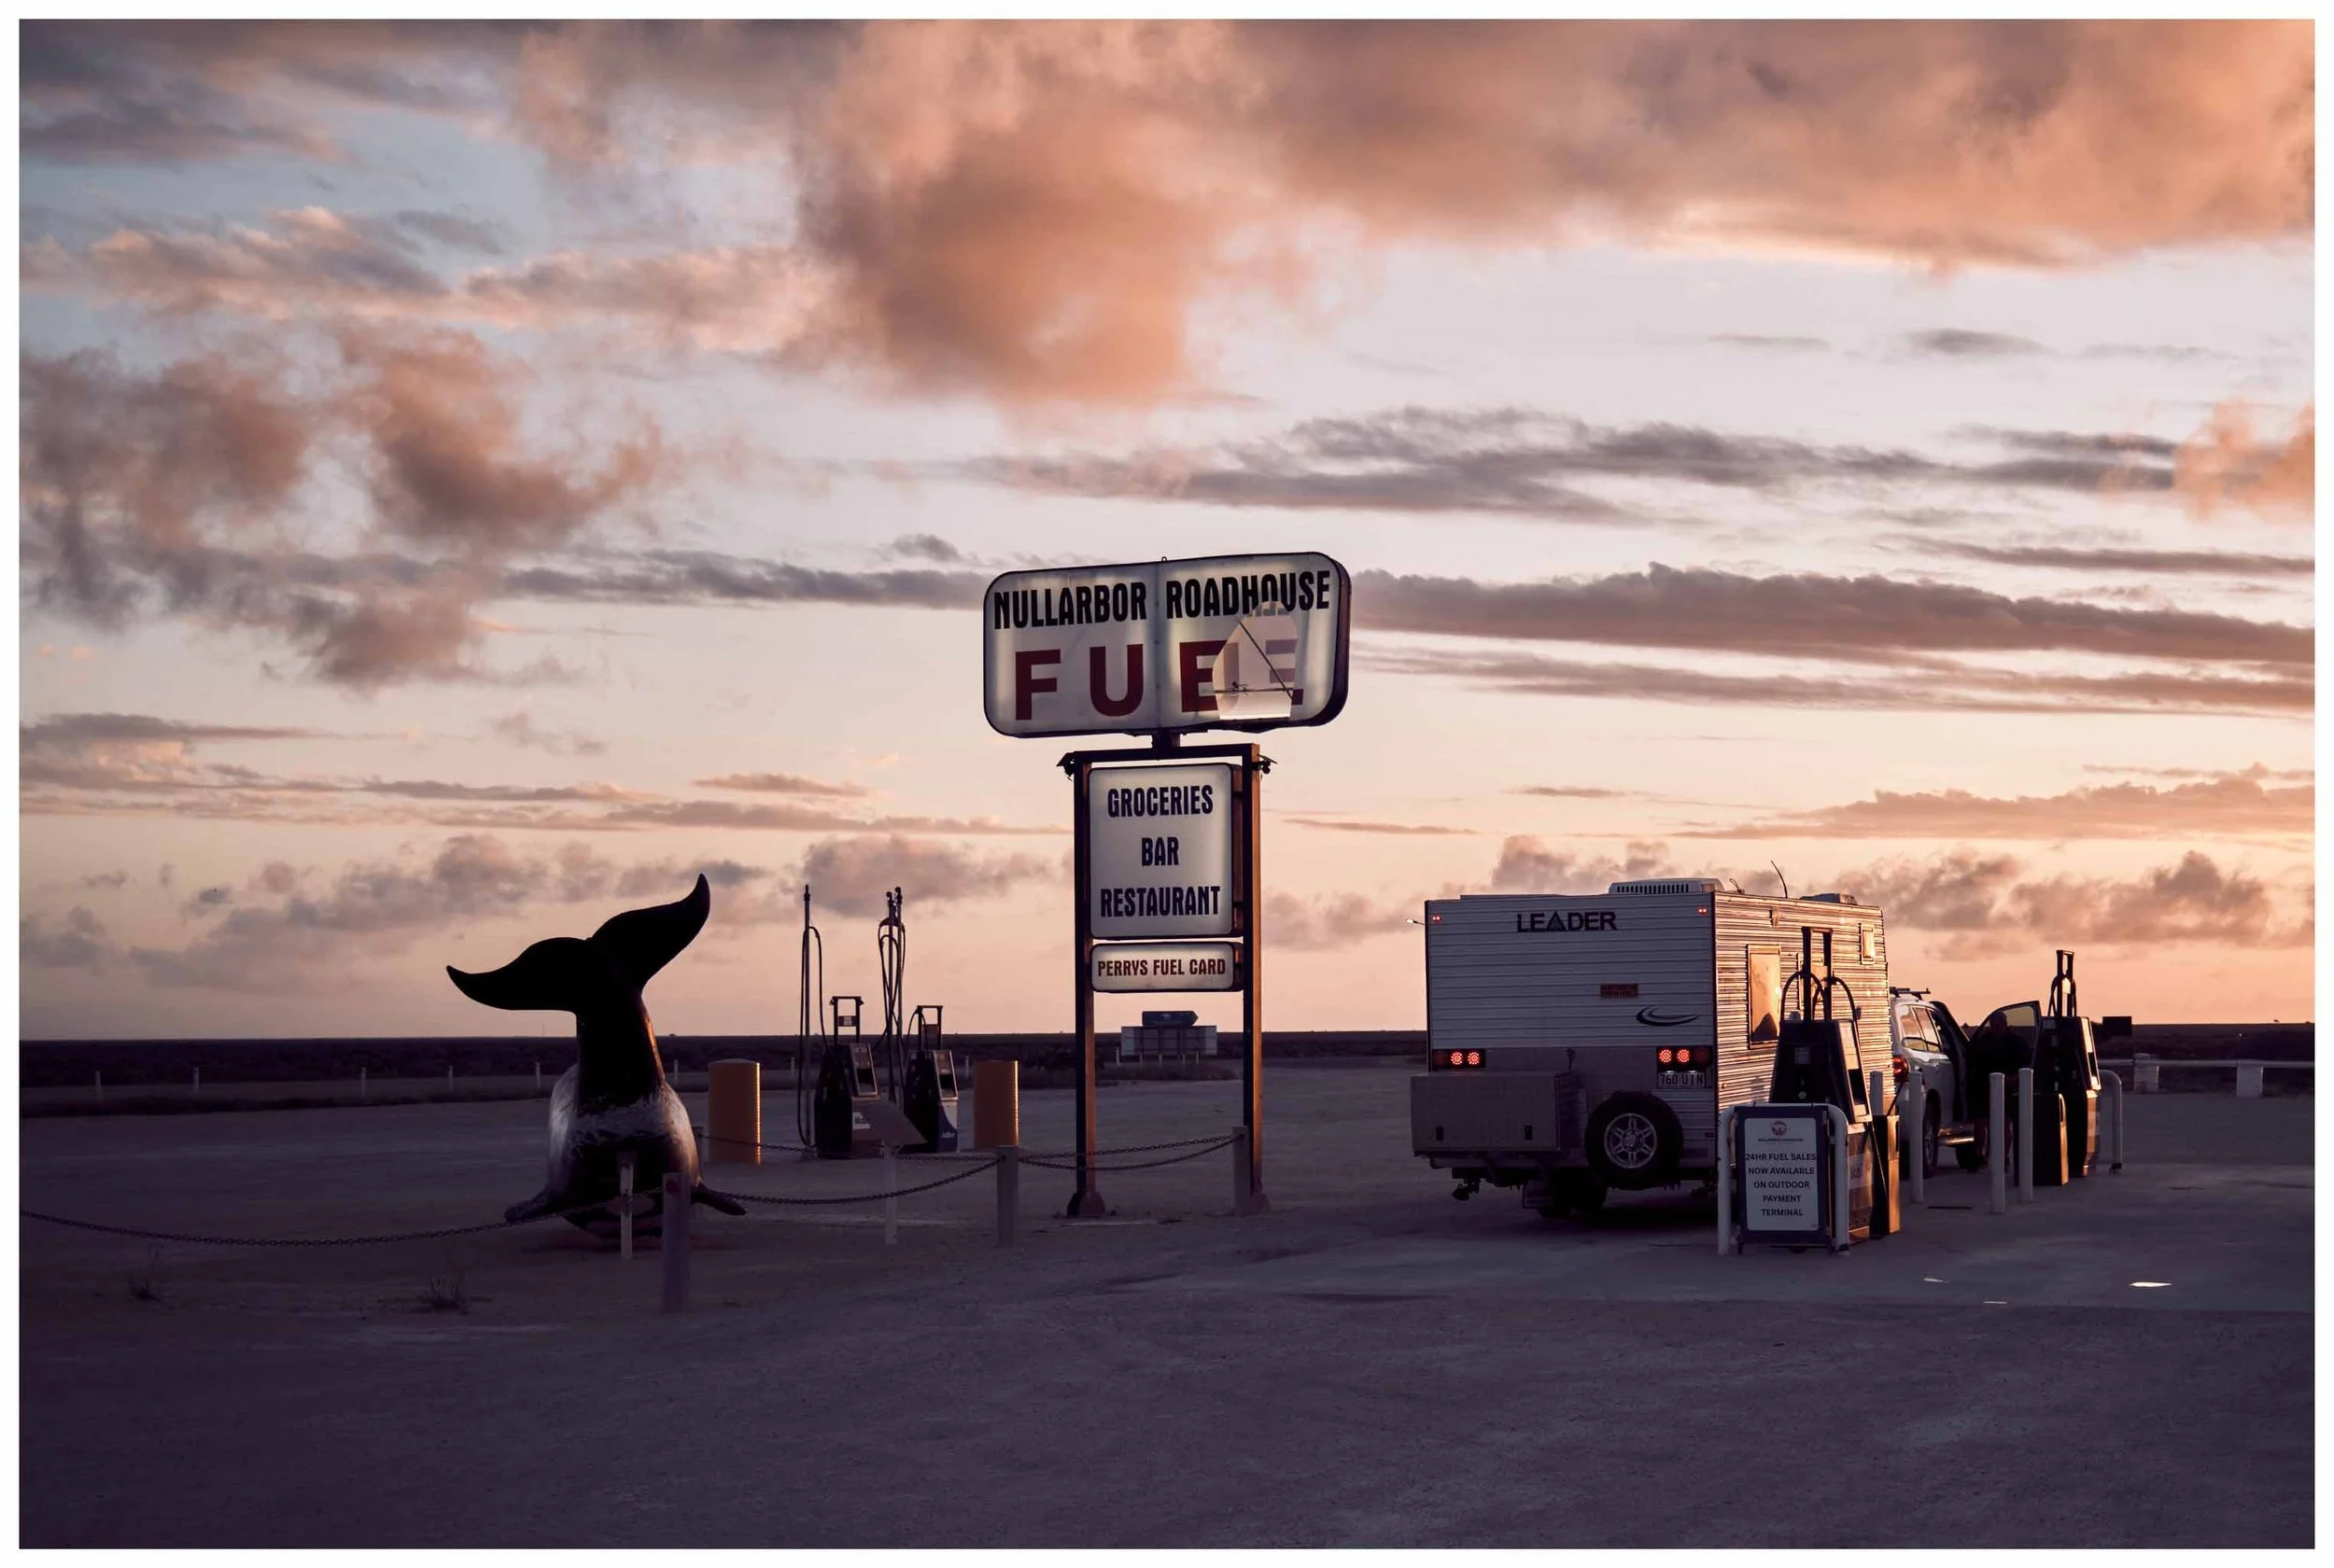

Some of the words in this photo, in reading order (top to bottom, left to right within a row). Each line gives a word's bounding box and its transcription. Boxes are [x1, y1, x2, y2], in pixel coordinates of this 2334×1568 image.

[994, 581, 1147, 629] NULLARBOR
[1166, 570, 1330, 619] ROADHOUSE
[1015, 639, 1303, 721] FUE
[1107, 785, 1214, 818] GROCERIES
[1141, 836, 1179, 866] BAR
[1101, 886, 1220, 918] RESTAURANT
[1516, 909, 1617, 933] LEADER
[1097, 959, 1148, 977] PERRYS
[1153, 959, 1185, 976] FUEL
[1189, 959, 1226, 975] CARD
[1659, 1073, 1678, 1085] 760
[1745, 1153, 1767, 1161] 24HR
[1768, 1153, 1790, 1161] FUEL
[1791, 1153, 1817, 1161] SALES
[1748, 1167, 1769, 1175] NOW
[1770, 1167, 1815, 1175] AVAILABLE
[1753, 1181, 1766, 1189] ON
[1767, 1181, 1810, 1189] OUTDOOR
[1762, 1195, 1802, 1203] PAYMENT
